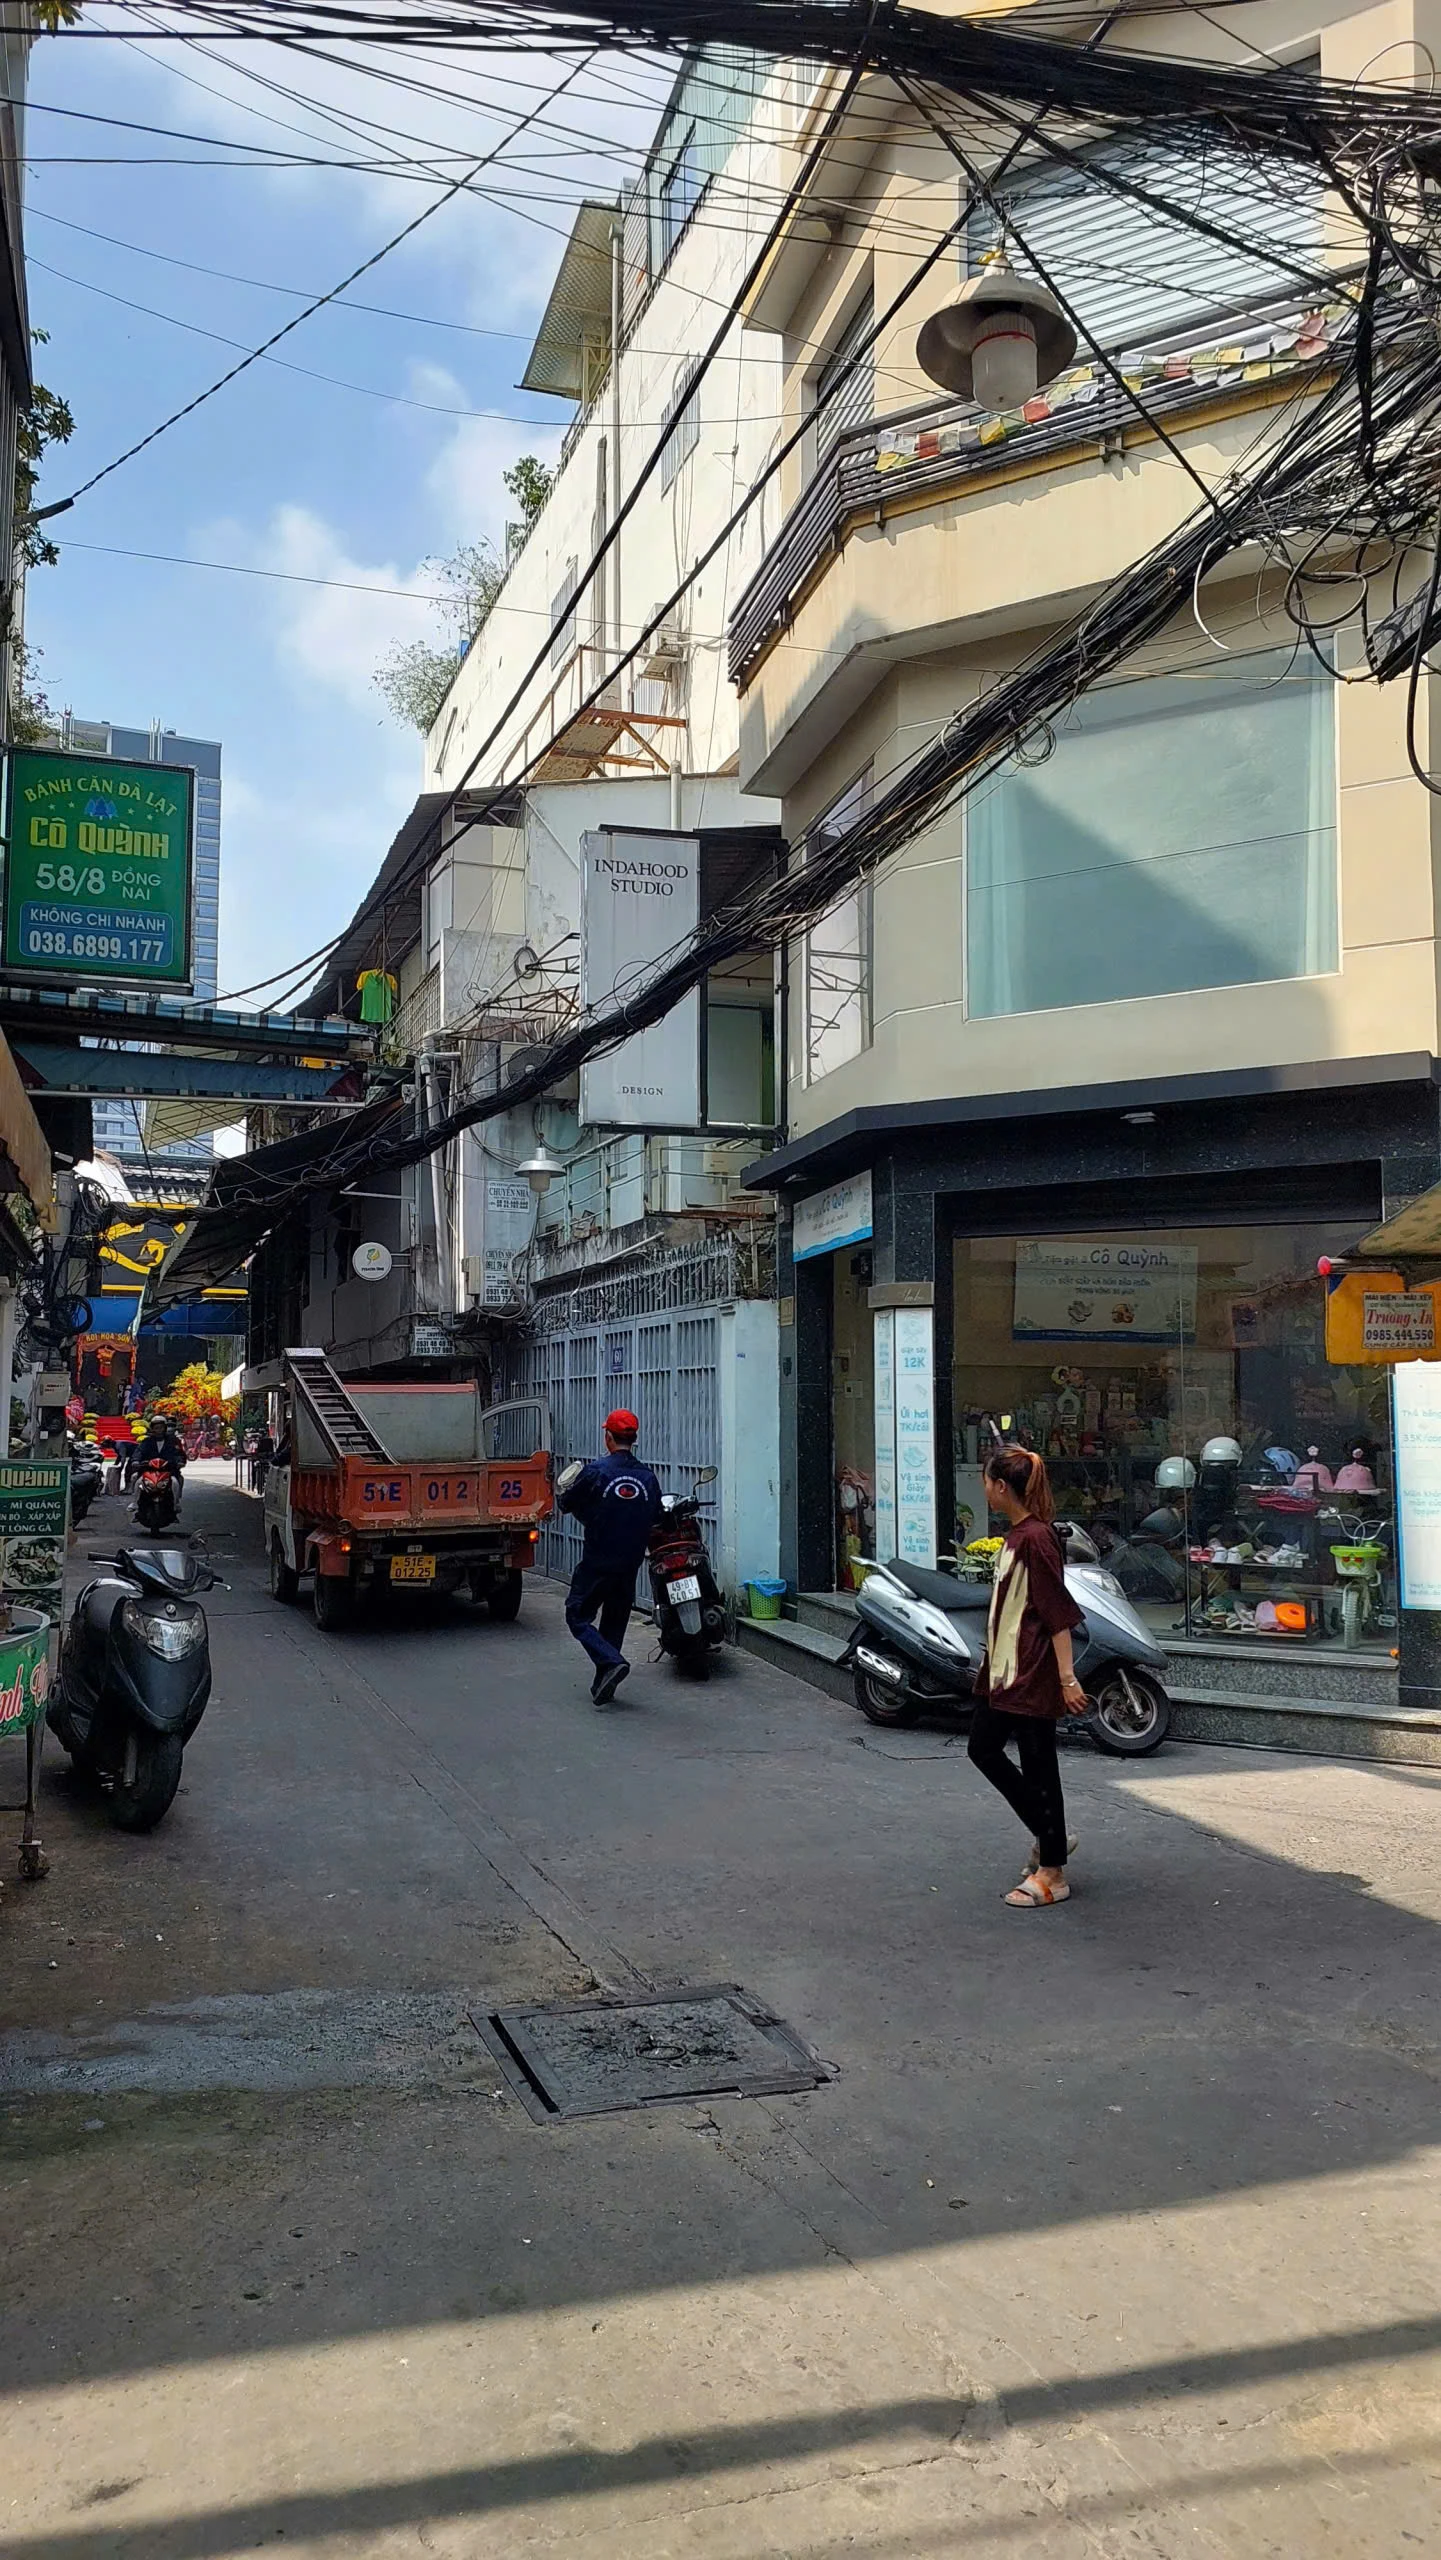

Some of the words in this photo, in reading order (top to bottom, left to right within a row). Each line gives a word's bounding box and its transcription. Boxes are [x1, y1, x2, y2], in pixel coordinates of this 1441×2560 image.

[24, 778, 72, 802] BÁNH
[77, 776, 113, 793] CĂN
[118, 782, 141, 800] ĐÀ
[145, 792, 177, 817] LẠT
[594, 859, 688, 879] INDAHOOD
[35, 863, 106, 896] 58/8
[111, 866, 161, 886] ĐỒNG
[611, 878, 673, 896] STUDIO
[122, 886, 150, 900] NAI
[30, 907, 82, 925] KHÔNG
[86, 913, 111, 927] CHI
[115, 914, 166, 931] NHÁNH
[29, 930, 164, 962] 038.6899.177
[622, 1086, 663, 1096] DESIGN
[1090, 1248, 1110, 1264] Cô
[1118, 1249, 1168, 1268] Quỳnh
[904, 1357, 925, 1368] 12K
[363, 1482, 401, 1501] 51E
[500, 1480, 522, 1499] 25
[10, 1500, 22, 1509] MÌ
[25, 1500, 61, 1510] QUẢNG
[38, 1522, 52, 1532] GÀ
[404, 1557, 424, 1566] 51E
[395, 1568, 430, 1577] 012.25
[672, 1579, 693, 1592] 49-B1
[670, 1587, 700, 1603] 540.51
